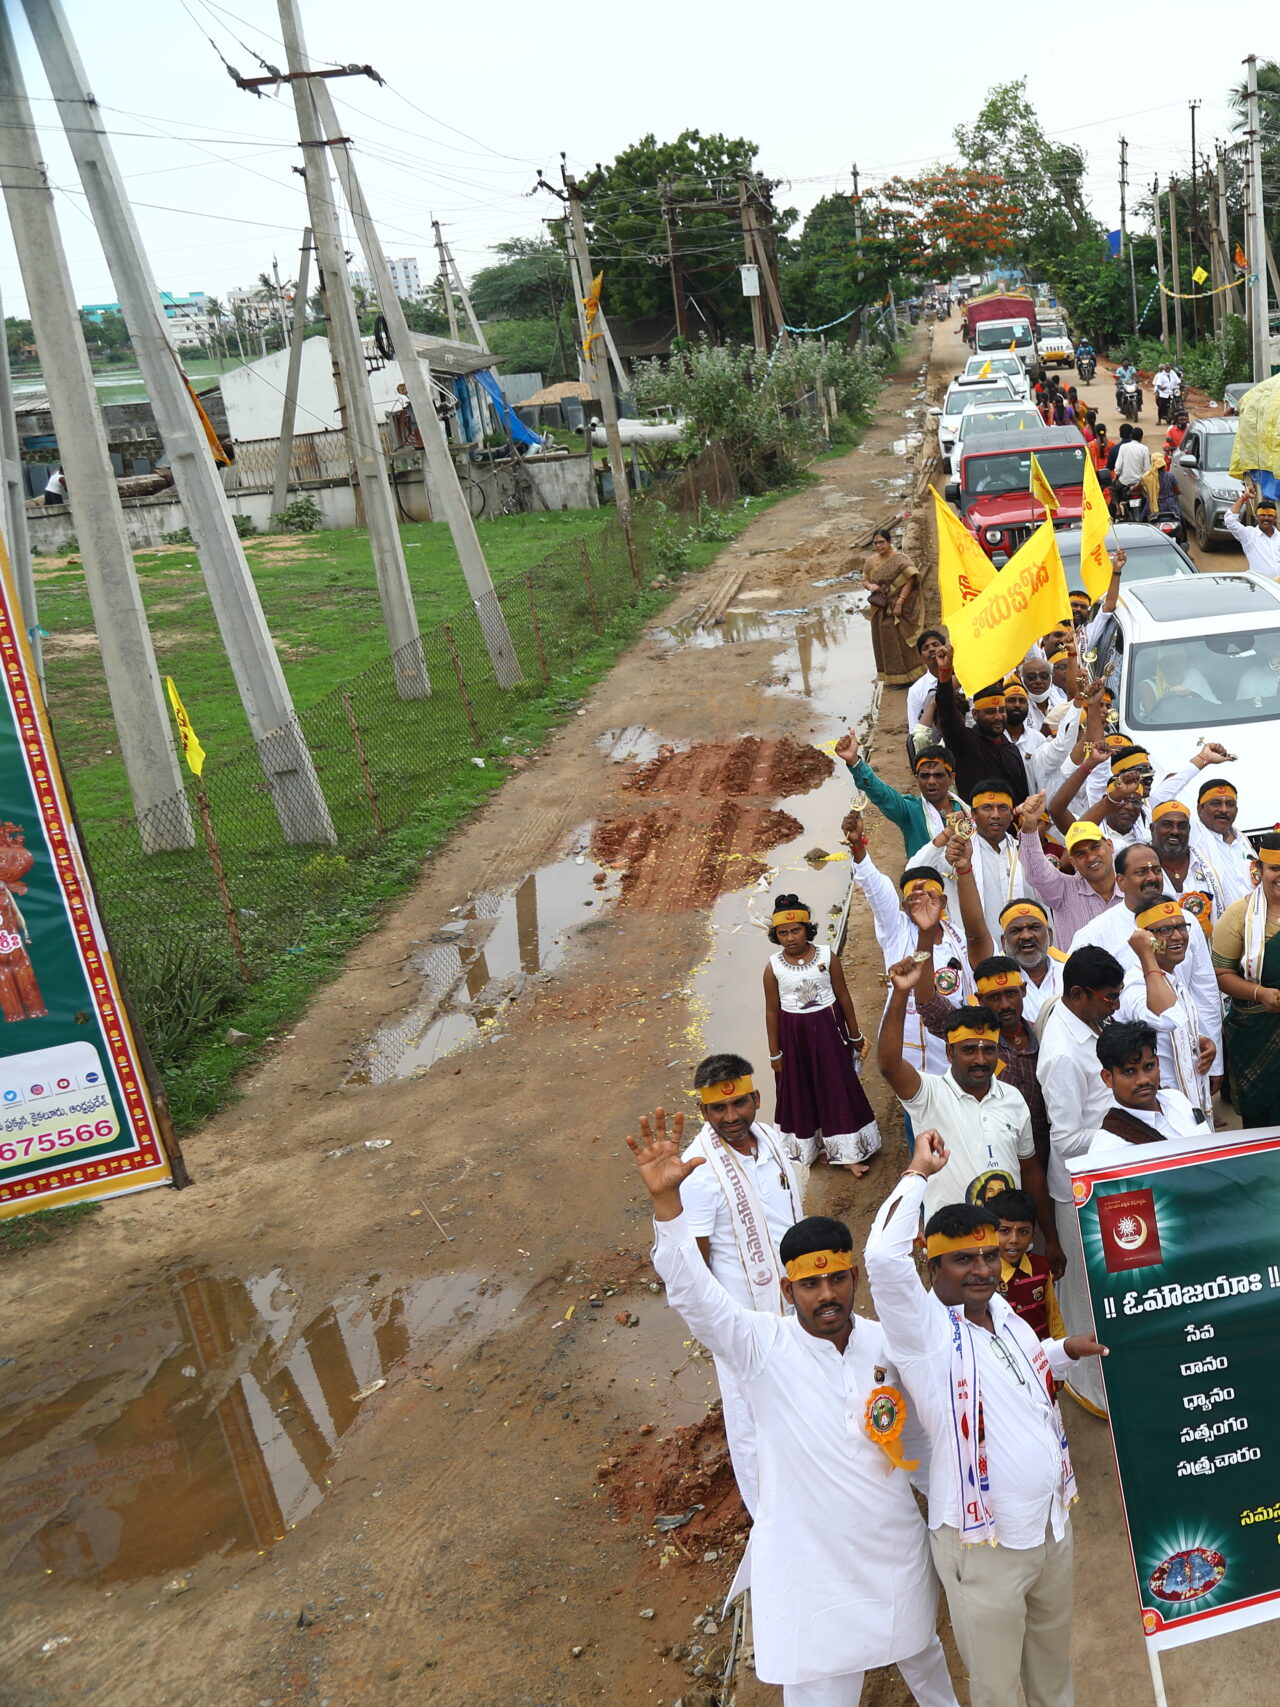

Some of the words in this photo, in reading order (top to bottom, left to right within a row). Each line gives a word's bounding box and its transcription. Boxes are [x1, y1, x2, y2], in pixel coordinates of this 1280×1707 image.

[1122, 1273, 1263, 1316] ఓమౌజయాః
[1184, 1324, 1215, 1343] సేవ
[1180, 1354, 1228, 1377] దానం
[1182, 1385, 1235, 1412] ధ్యానం
[1180, 1415, 1249, 1444] సత్సంగం
